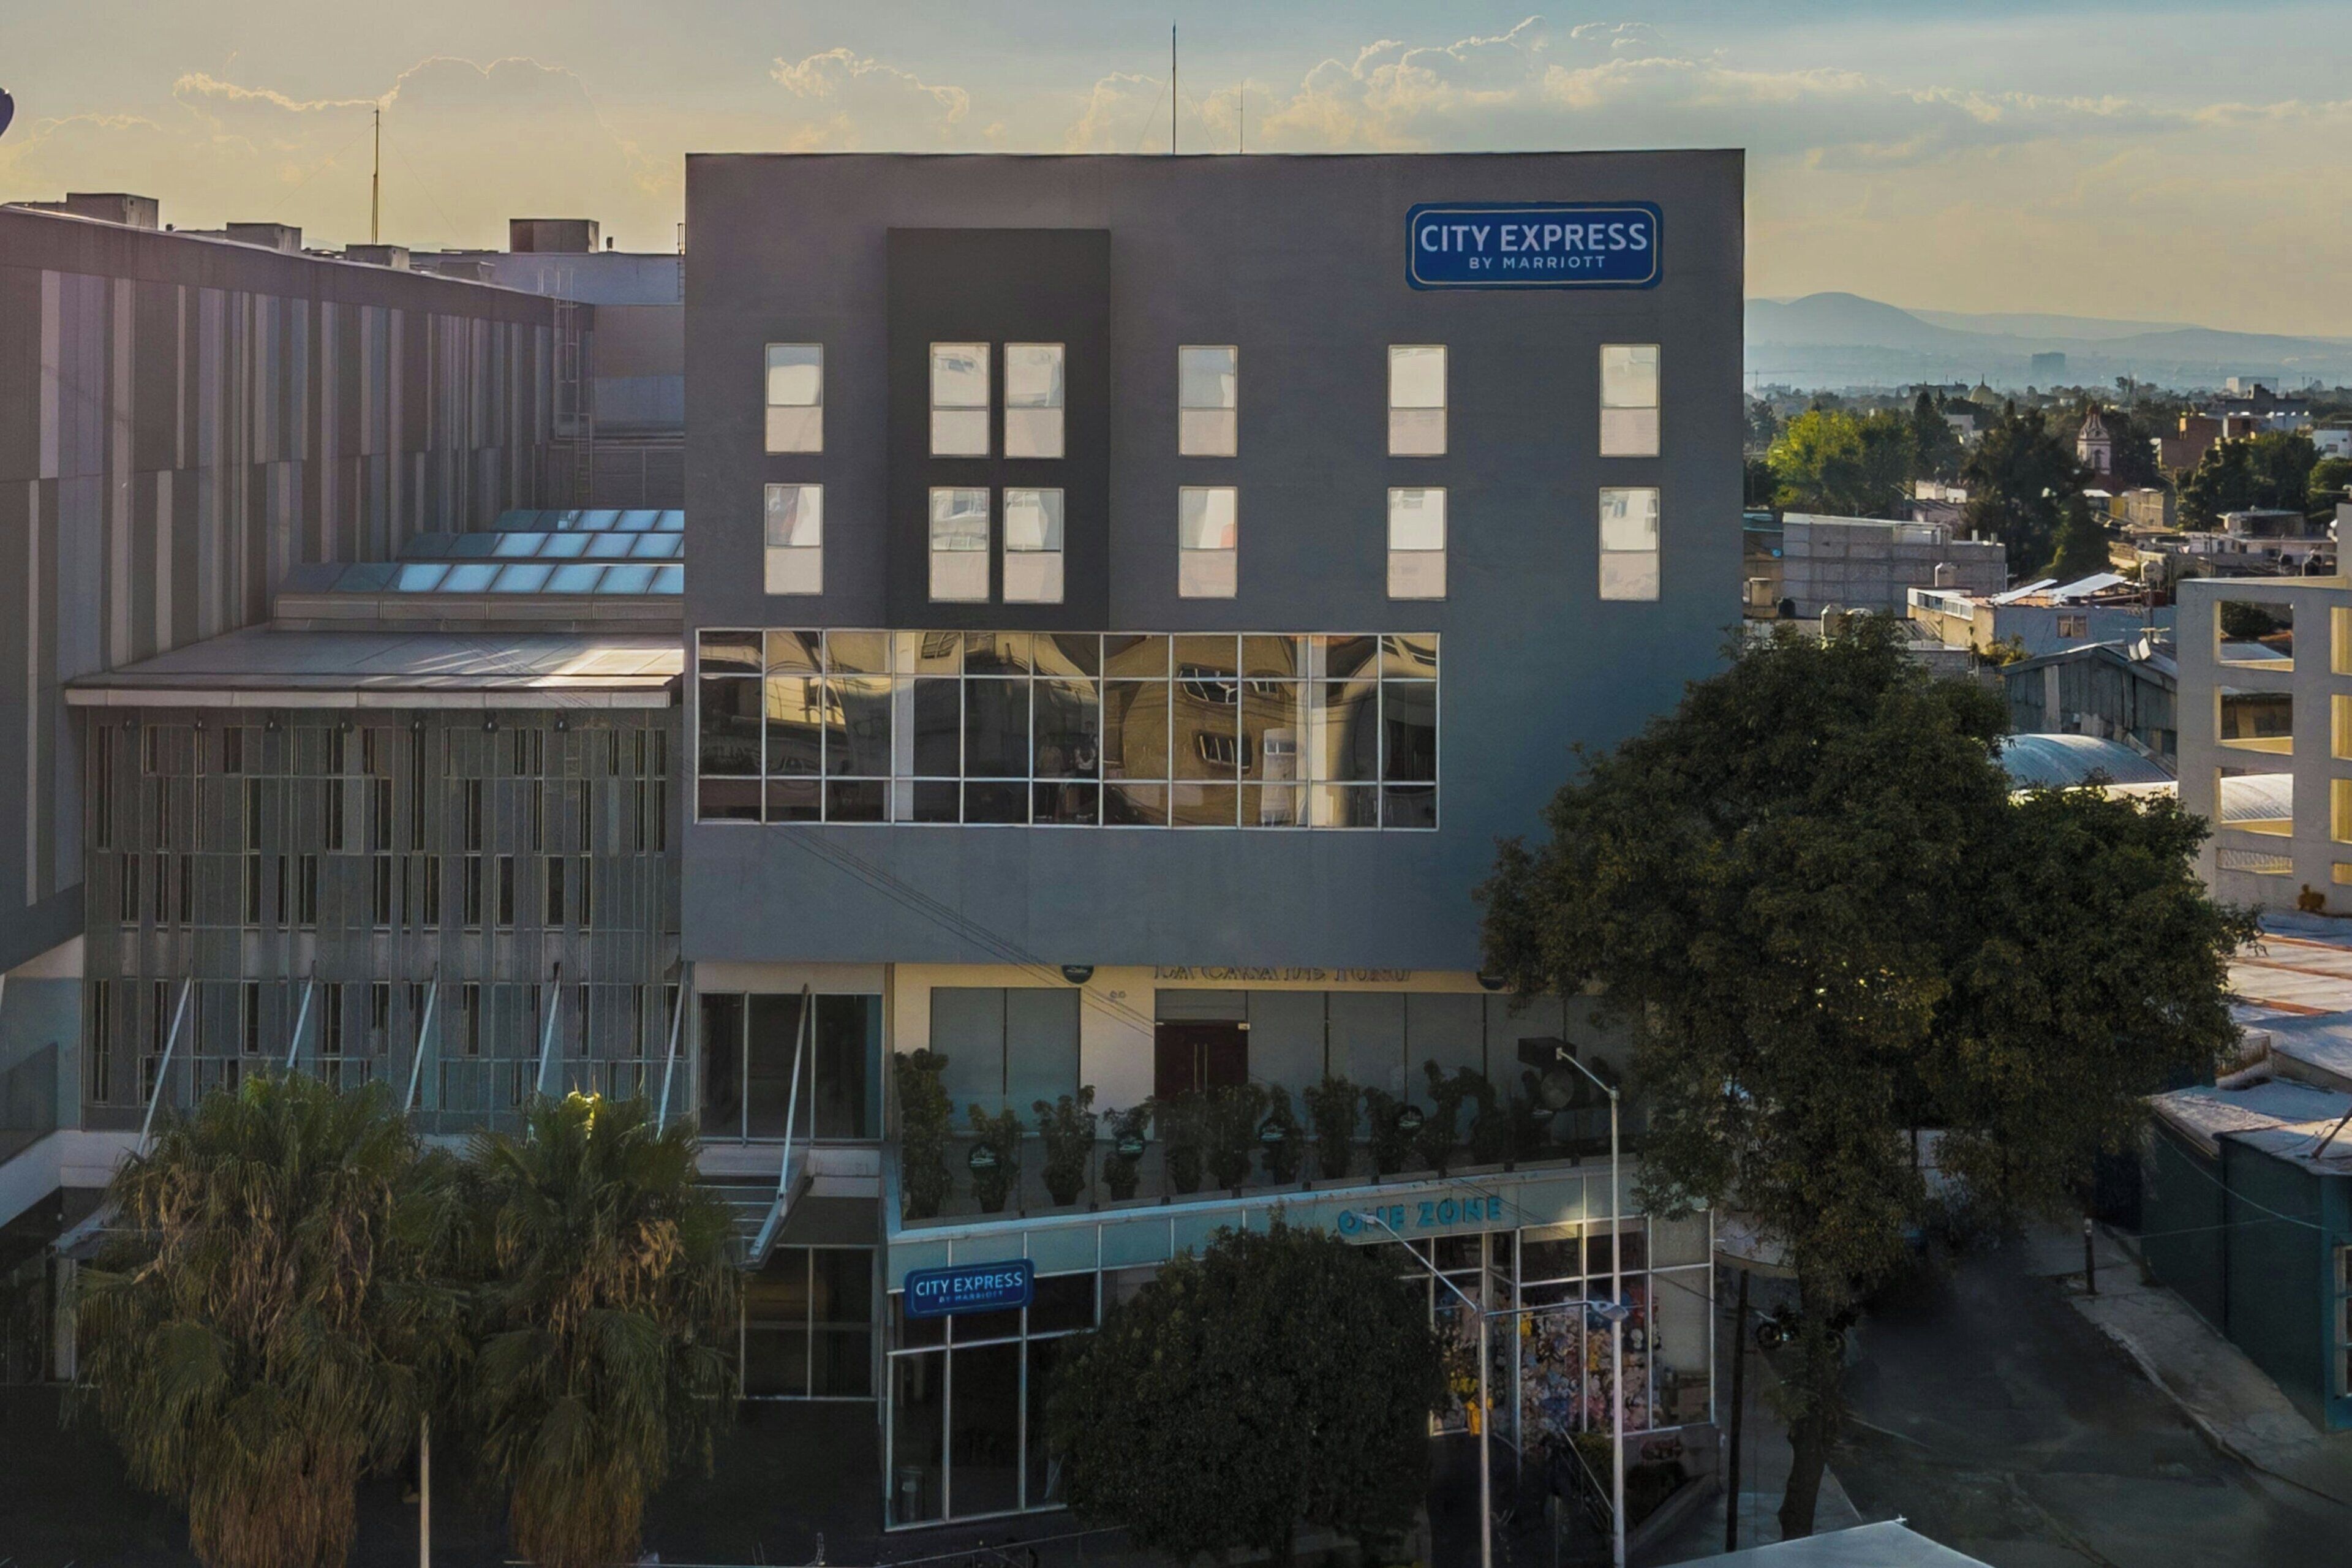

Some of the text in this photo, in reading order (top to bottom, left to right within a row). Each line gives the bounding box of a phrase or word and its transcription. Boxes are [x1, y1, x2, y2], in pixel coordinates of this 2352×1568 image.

[1420, 223, 1648, 252] CITY EXPRESS
[1469, 255, 1605, 270] BY MARRIOTT
[1416, 1195, 1502, 1227] ZONE
[916, 1272, 1023, 1296] CITY EXPRESS
[938, 1290, 1003, 1303] BY MARRIOTT
